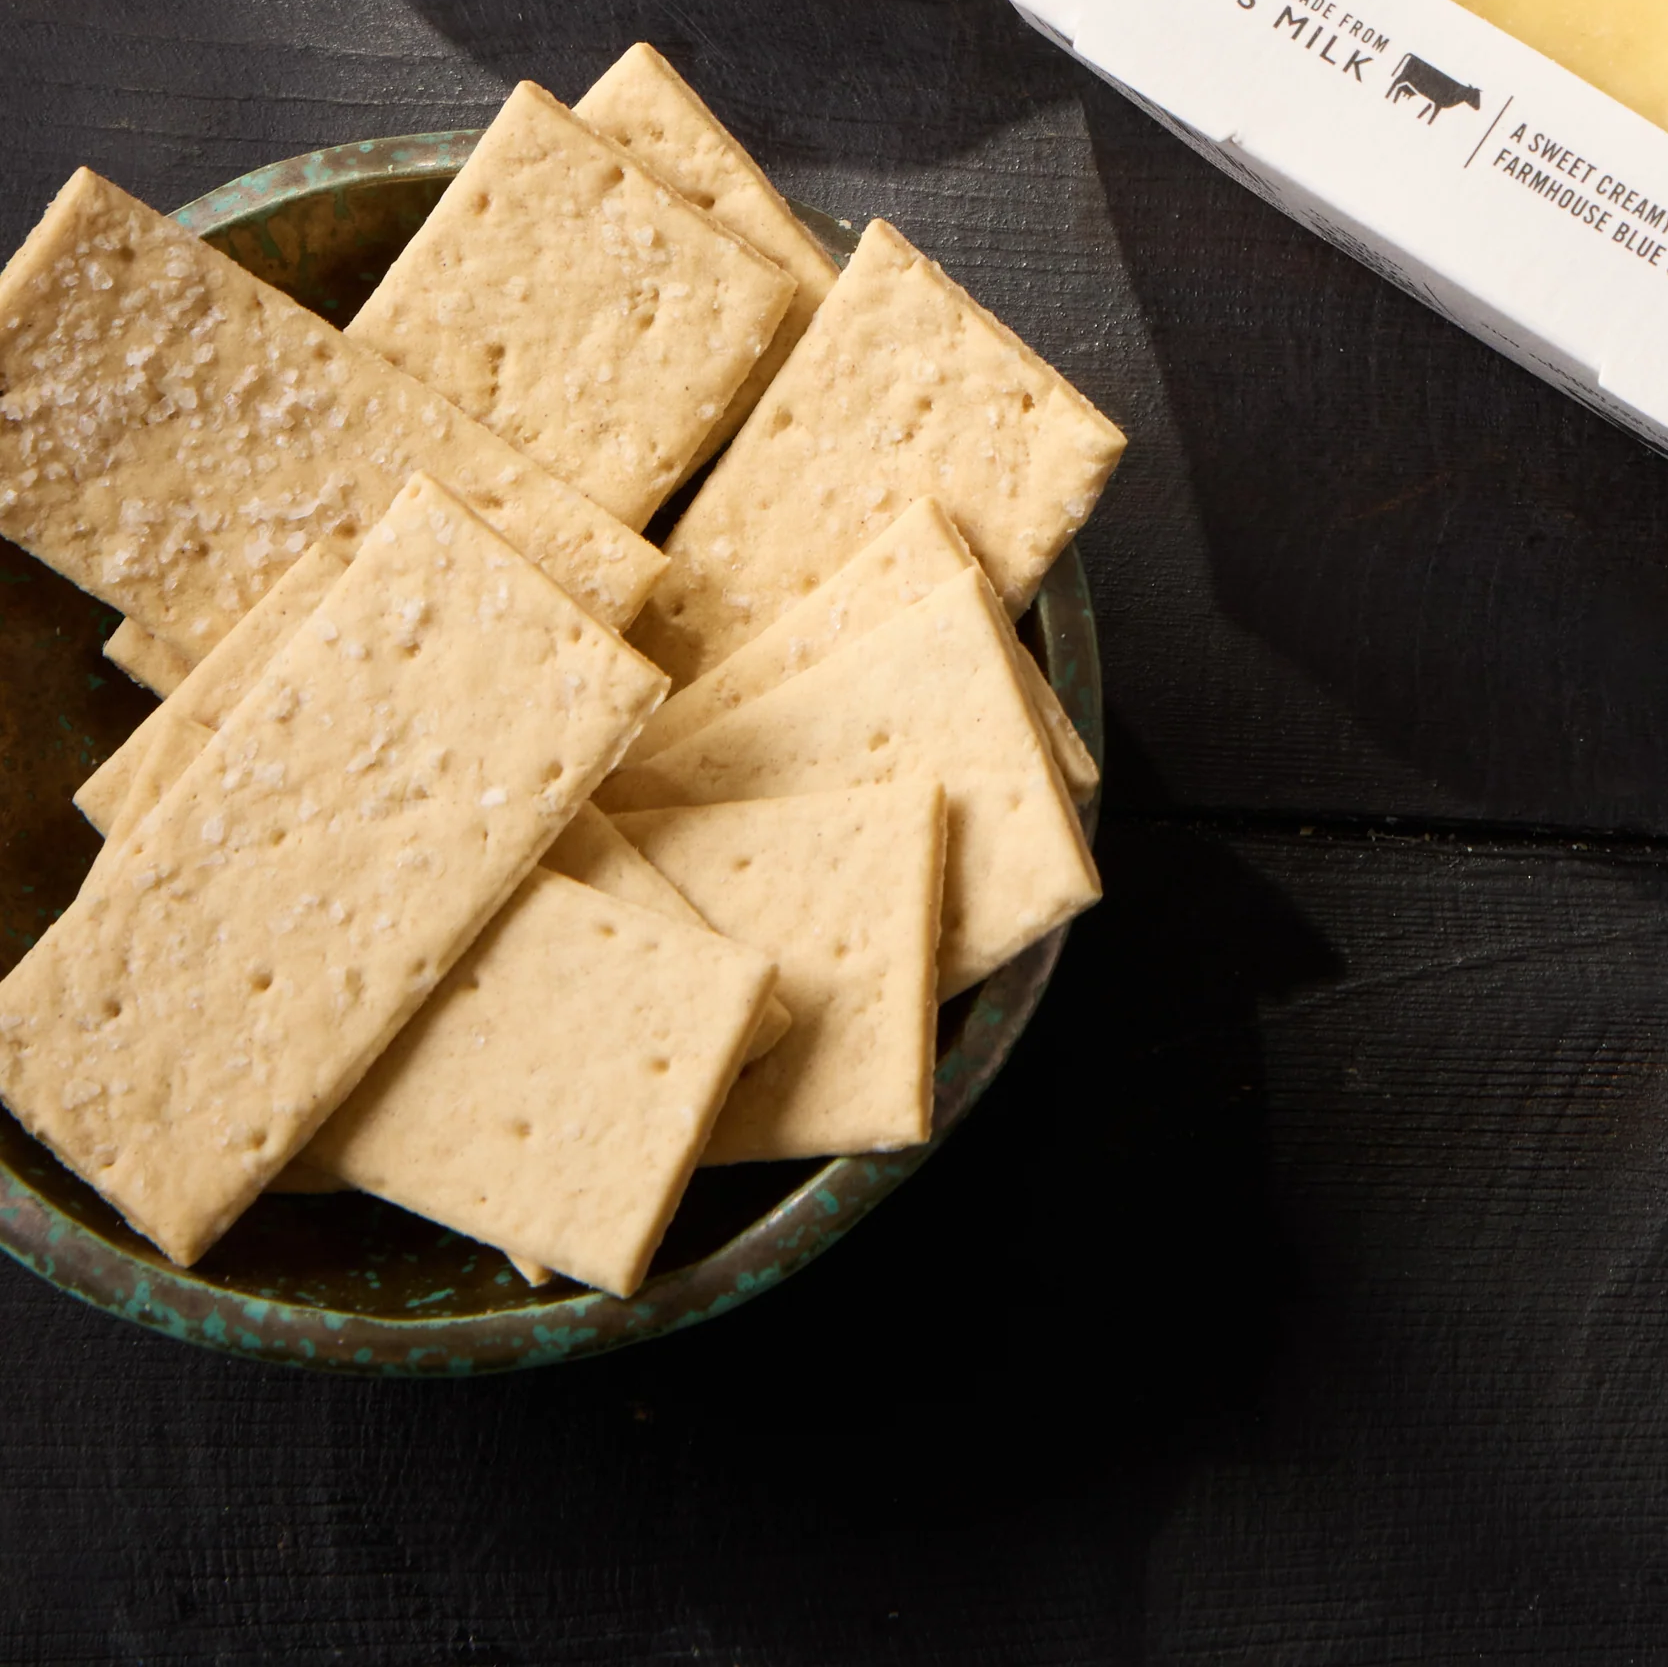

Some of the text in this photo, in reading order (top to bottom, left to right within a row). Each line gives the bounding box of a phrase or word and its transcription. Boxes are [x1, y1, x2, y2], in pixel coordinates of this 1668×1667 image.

[1272, 5, 1375, 84] MILK
[1338, 13, 1391, 54] FROM
[1509, 122, 1528, 145] A
[1528, 132, 1597, 184] SWEET
[1493, 147, 1613, 234] FARMHOUSE
[1611, 221, 1667, 267] BLUE
